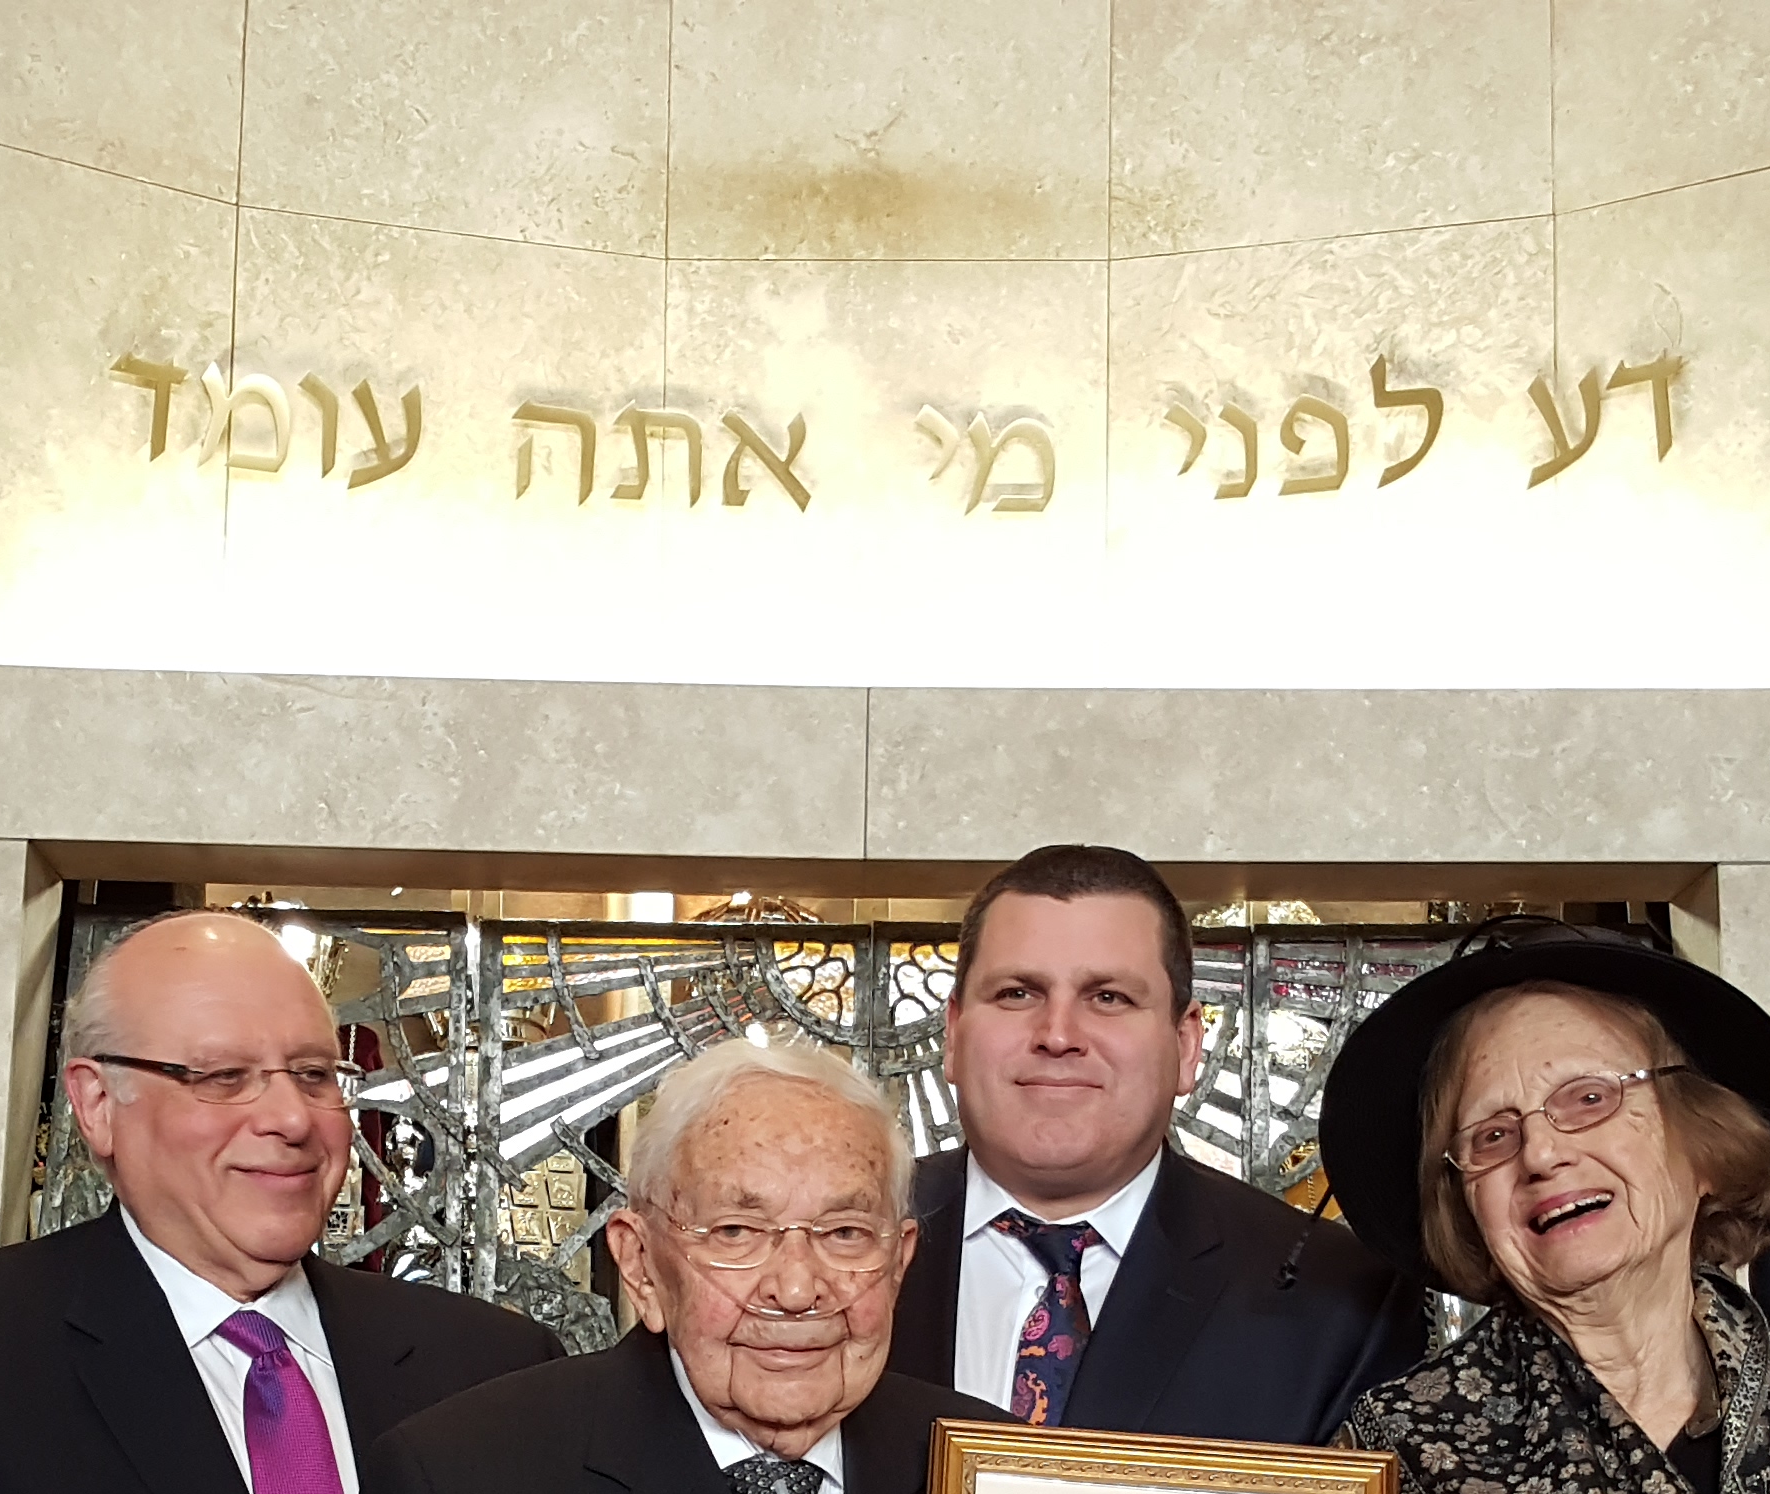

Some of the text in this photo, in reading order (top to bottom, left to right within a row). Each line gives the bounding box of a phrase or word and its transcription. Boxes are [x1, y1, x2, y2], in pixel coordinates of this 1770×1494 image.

[109, 349, 1685, 516] דע לפני מי אתה עומד
